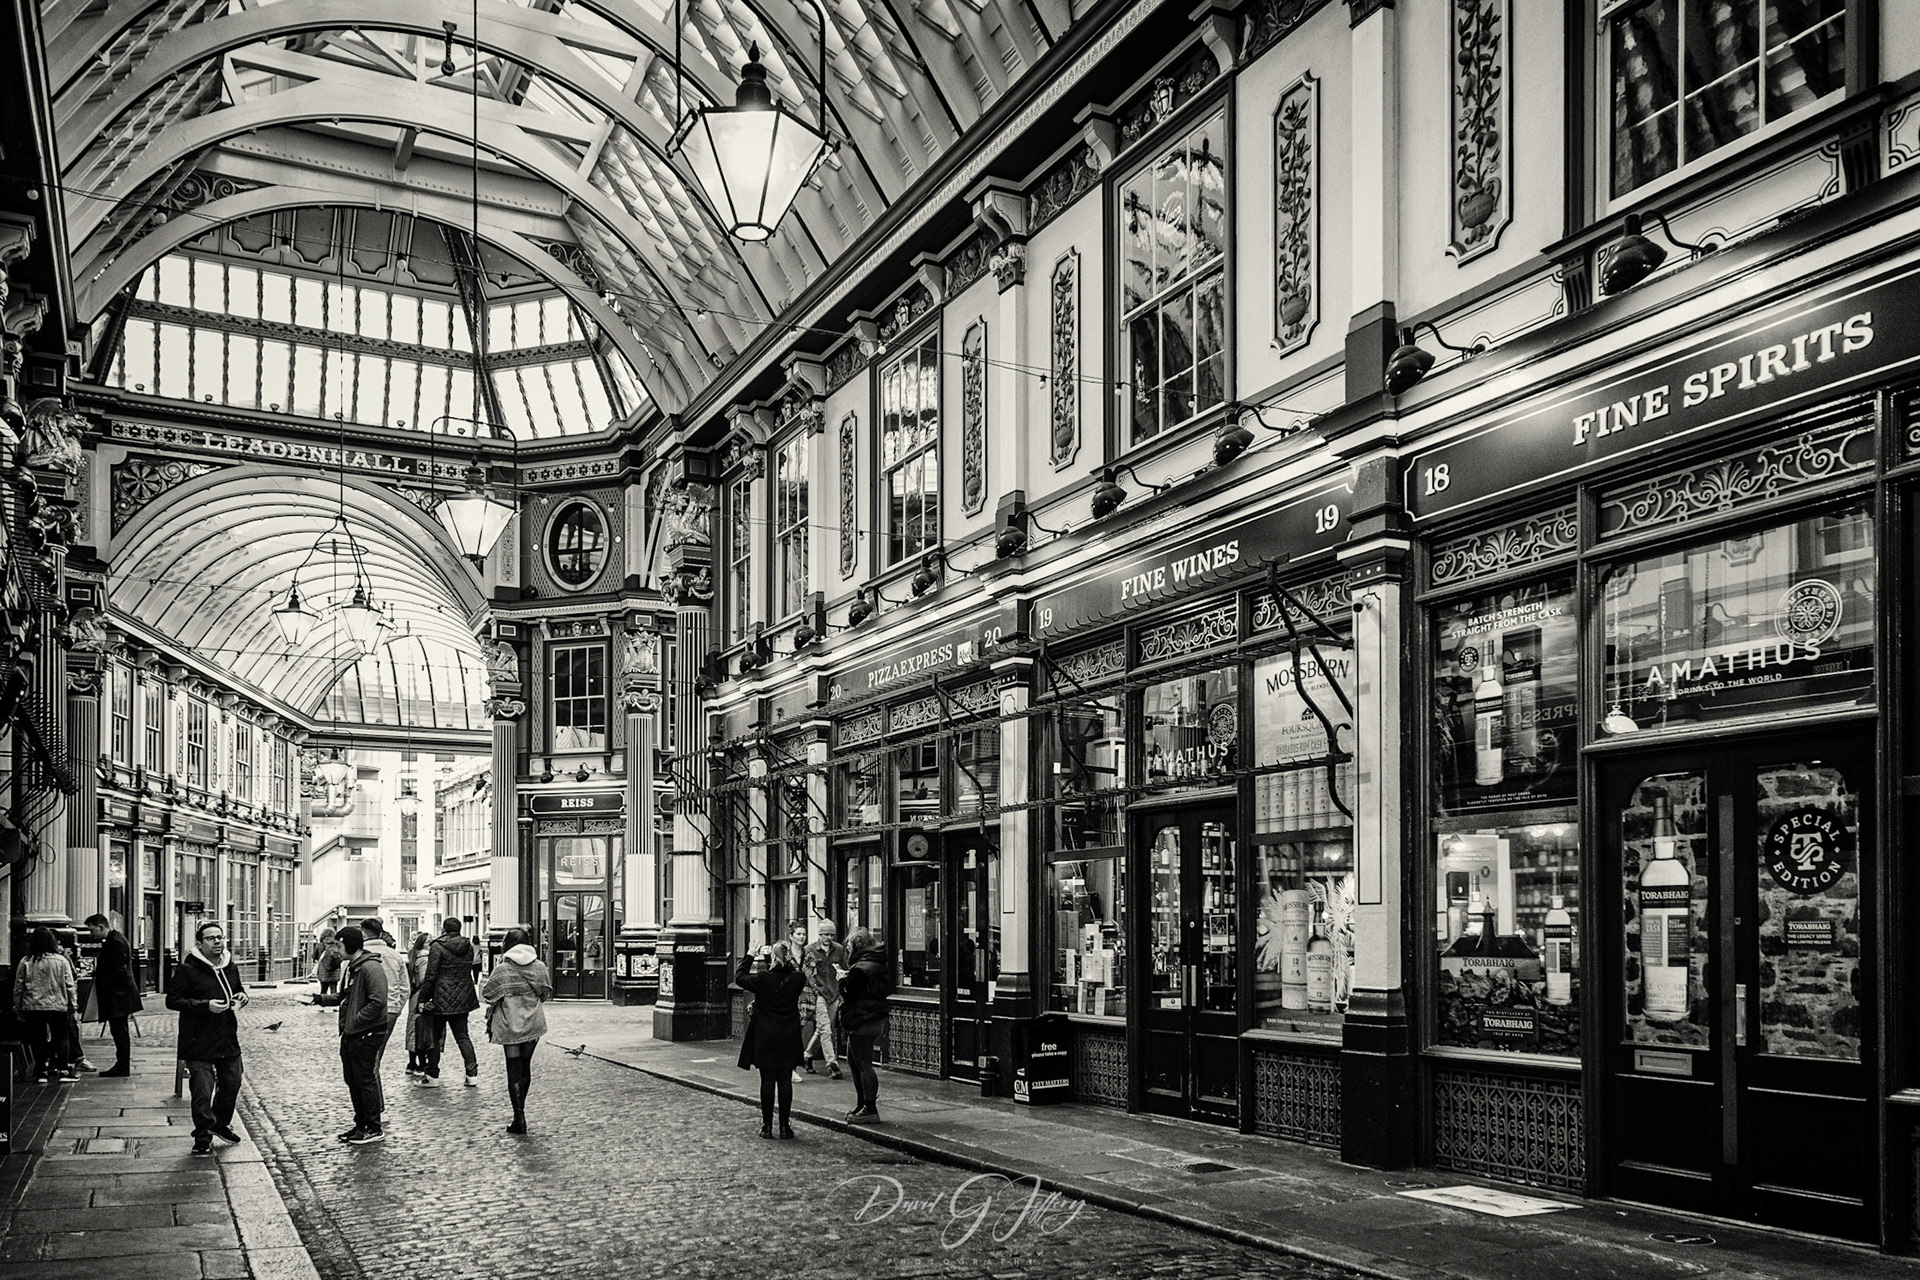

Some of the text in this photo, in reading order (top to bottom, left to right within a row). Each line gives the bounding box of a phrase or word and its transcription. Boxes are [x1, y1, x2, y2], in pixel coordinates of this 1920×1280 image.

[1573, 312, 1874, 446] FINE SPIRITS
[202, 432, 410, 474] LEADENHALL
[1424, 463, 1450, 496] 18
[1315, 504, 1340, 534] 19
[1120, 540, 1240, 600] FINE WINES
[1038, 608, 1052, 630] 19
[1451, 607, 1562, 639] STRAIGHT FROM THE CASK
[1468, 602, 1543, 626] BATCH STRENGTH
[984, 626, 1002, 648] 20
[868, 643, 953, 689] PIZZAEXPRESS
[1646, 638, 1821, 687] AMATHUS
[830, 684, 841, 700] 20
[1728, 678, 1745, 687] THE
[1748, 673, 1783, 684] WORLD
[1153, 742, 1228, 769] AMATHUS
[561, 798, 594, 808] REISS
[1774, 814, 1840, 844] SPECIAL
[561, 857, 599, 867] REISS
[1773, 861, 1841, 889] EDITION
[1641, 891, 1689, 900] TORABHAIG
[1462, 957, 1515, 967] TORABHAIG
[1483, 1017, 1533, 1029] TORABHAIG
[1041, 1042, 1057, 1051] free
